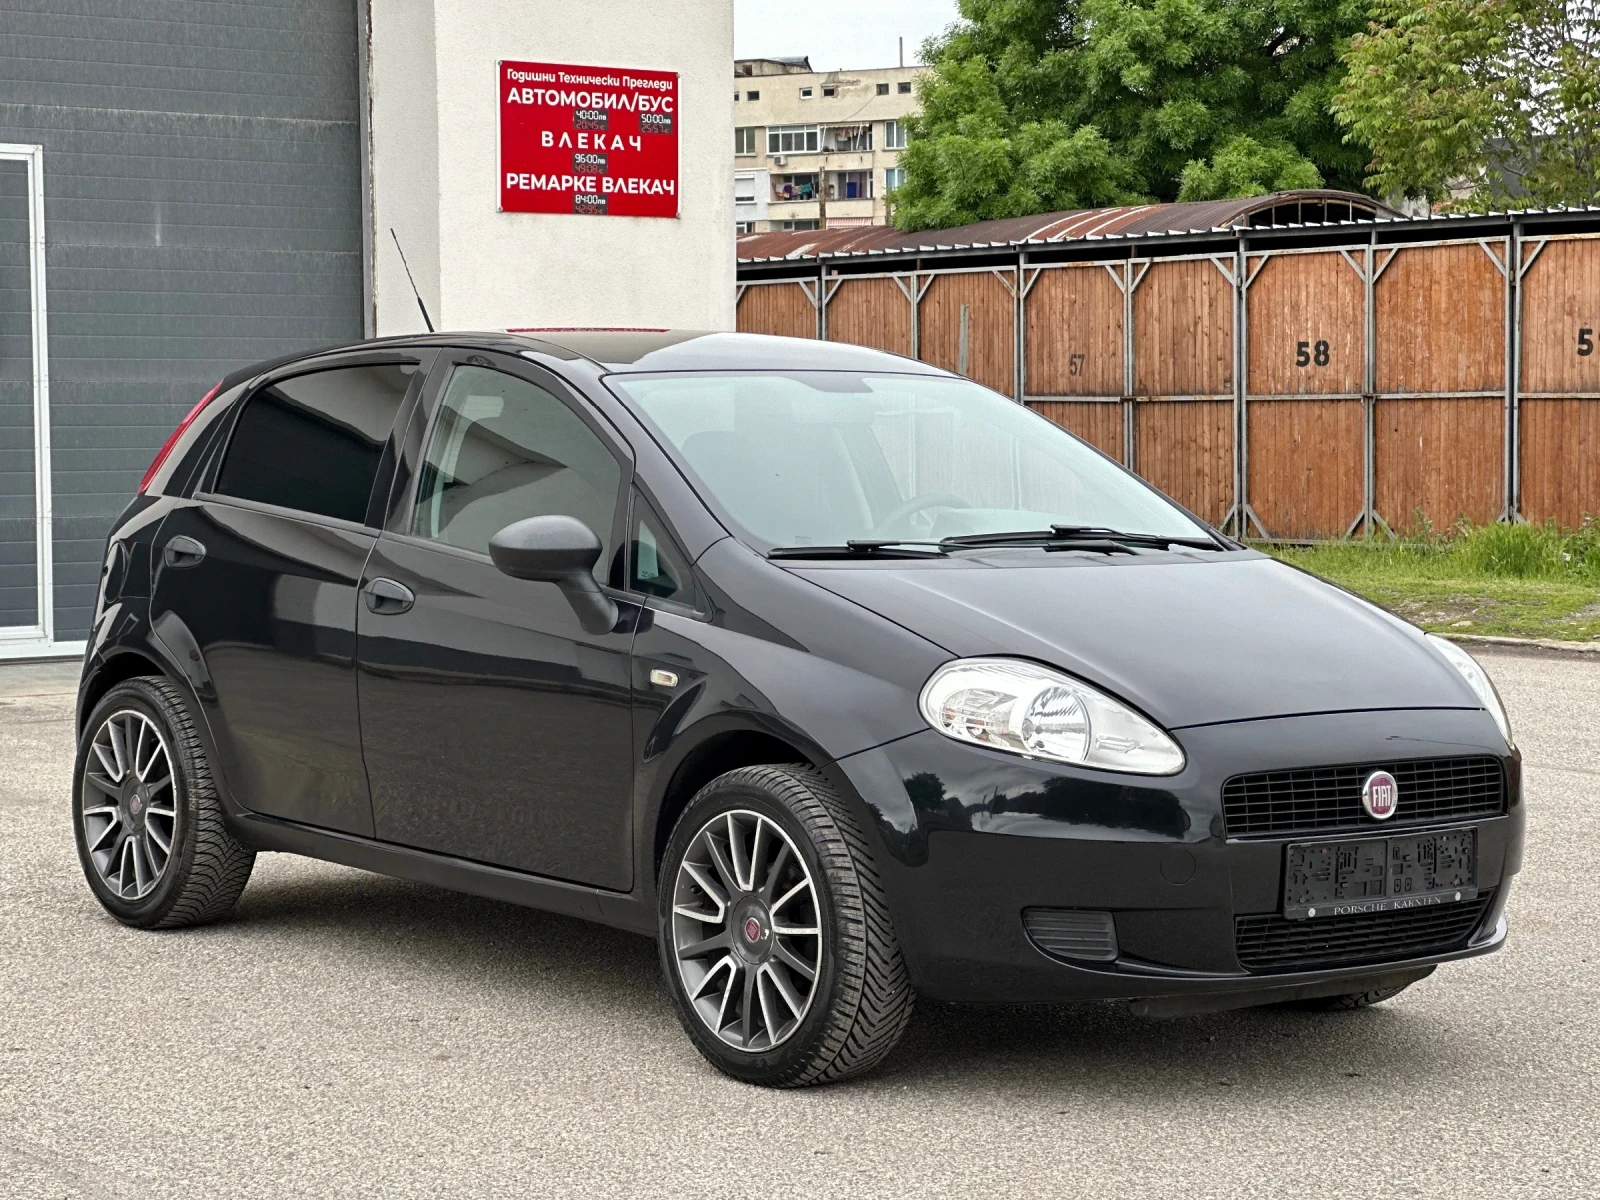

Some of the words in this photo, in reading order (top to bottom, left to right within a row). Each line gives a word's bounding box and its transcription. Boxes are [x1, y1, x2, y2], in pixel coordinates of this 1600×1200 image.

[507, 68, 556, 83] Годишни
[558, 72, 620, 87] Технически
[622, 76, 673, 92] Прегледи
[507, 87, 674, 113] АВТОМОБИЛ/БУС
[541, 131, 641, 151] ВЛЕКАЧ
[506, 173, 597, 192] РЕМАРКЕ
[602, 176, 675, 195] ВЛЕКАЧ
[1577, 328, 1600, 356] 5
[1295, 340, 1330, 367] 58
[1069, 354, 1086, 376] 57
[1372, 785, 1393, 807] FIAT
[1334, 902, 1387, 915] PORSCHE
